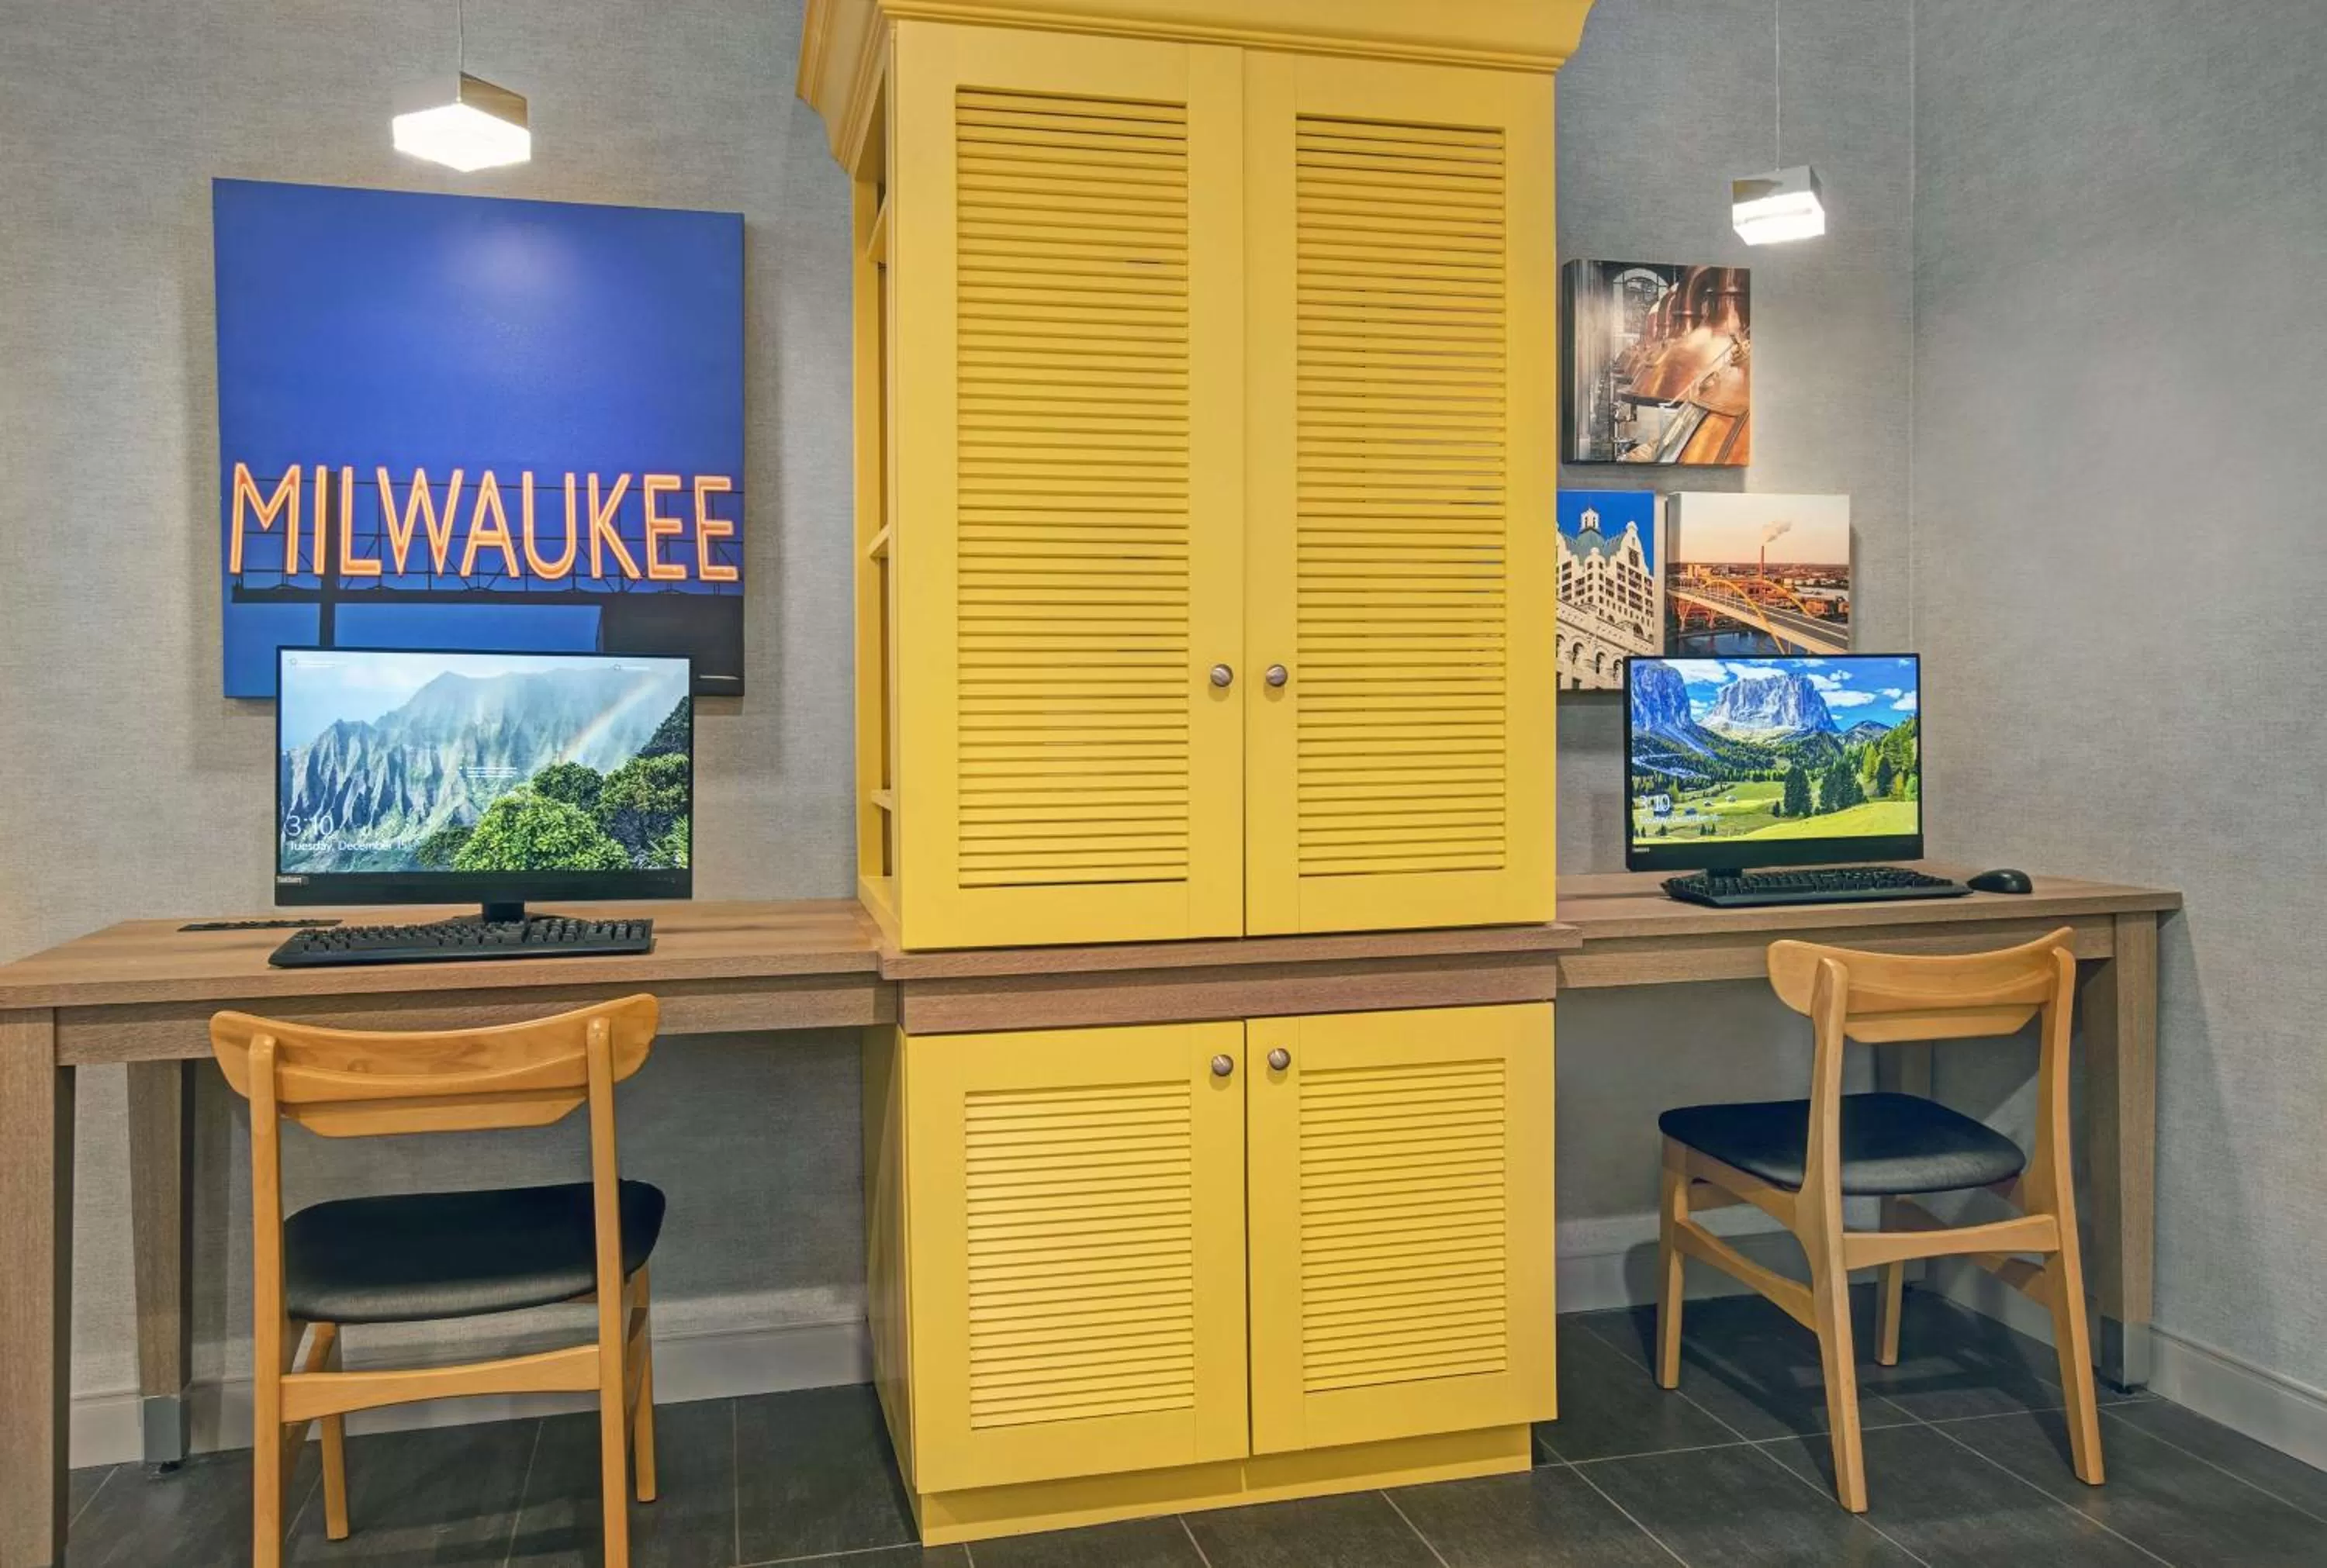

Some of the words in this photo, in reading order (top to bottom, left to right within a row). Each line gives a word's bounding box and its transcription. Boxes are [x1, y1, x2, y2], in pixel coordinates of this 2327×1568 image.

[230, 462, 738, 582] MILWAUKEE
[285, 815, 334, 837] 3:10
[338, 839, 392, 851] December
